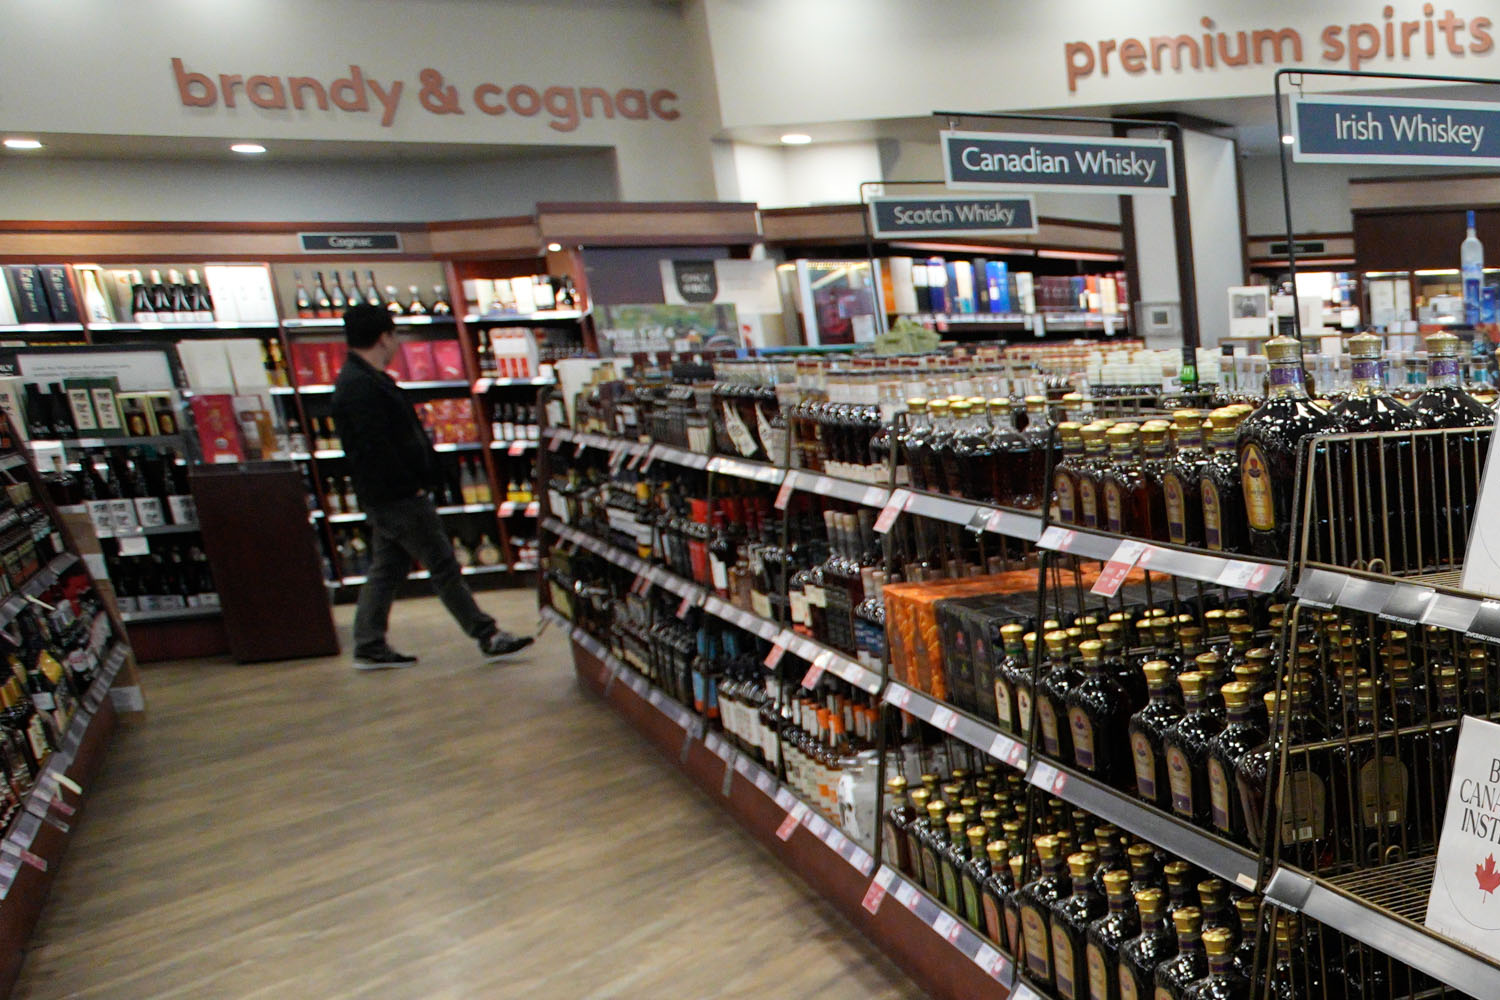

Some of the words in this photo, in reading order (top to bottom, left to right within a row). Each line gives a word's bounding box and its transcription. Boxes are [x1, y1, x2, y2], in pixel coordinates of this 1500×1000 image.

[1065, 16, 1303, 92] premium
[1322, 3, 1494, 71] spirits
[171, 57, 403, 127] brandy
[418, 68, 464, 115] &
[474, 82, 681, 132] cognac
[1335, 112, 1383, 142] Irish
[1389, 115, 1485, 152] Whiskey
[961, 146, 1069, 174] Canadian
[1075, 150, 1156, 182] Whisky
[893, 204, 953, 225] Scotch
[955, 205, 1015, 227] Whisky
